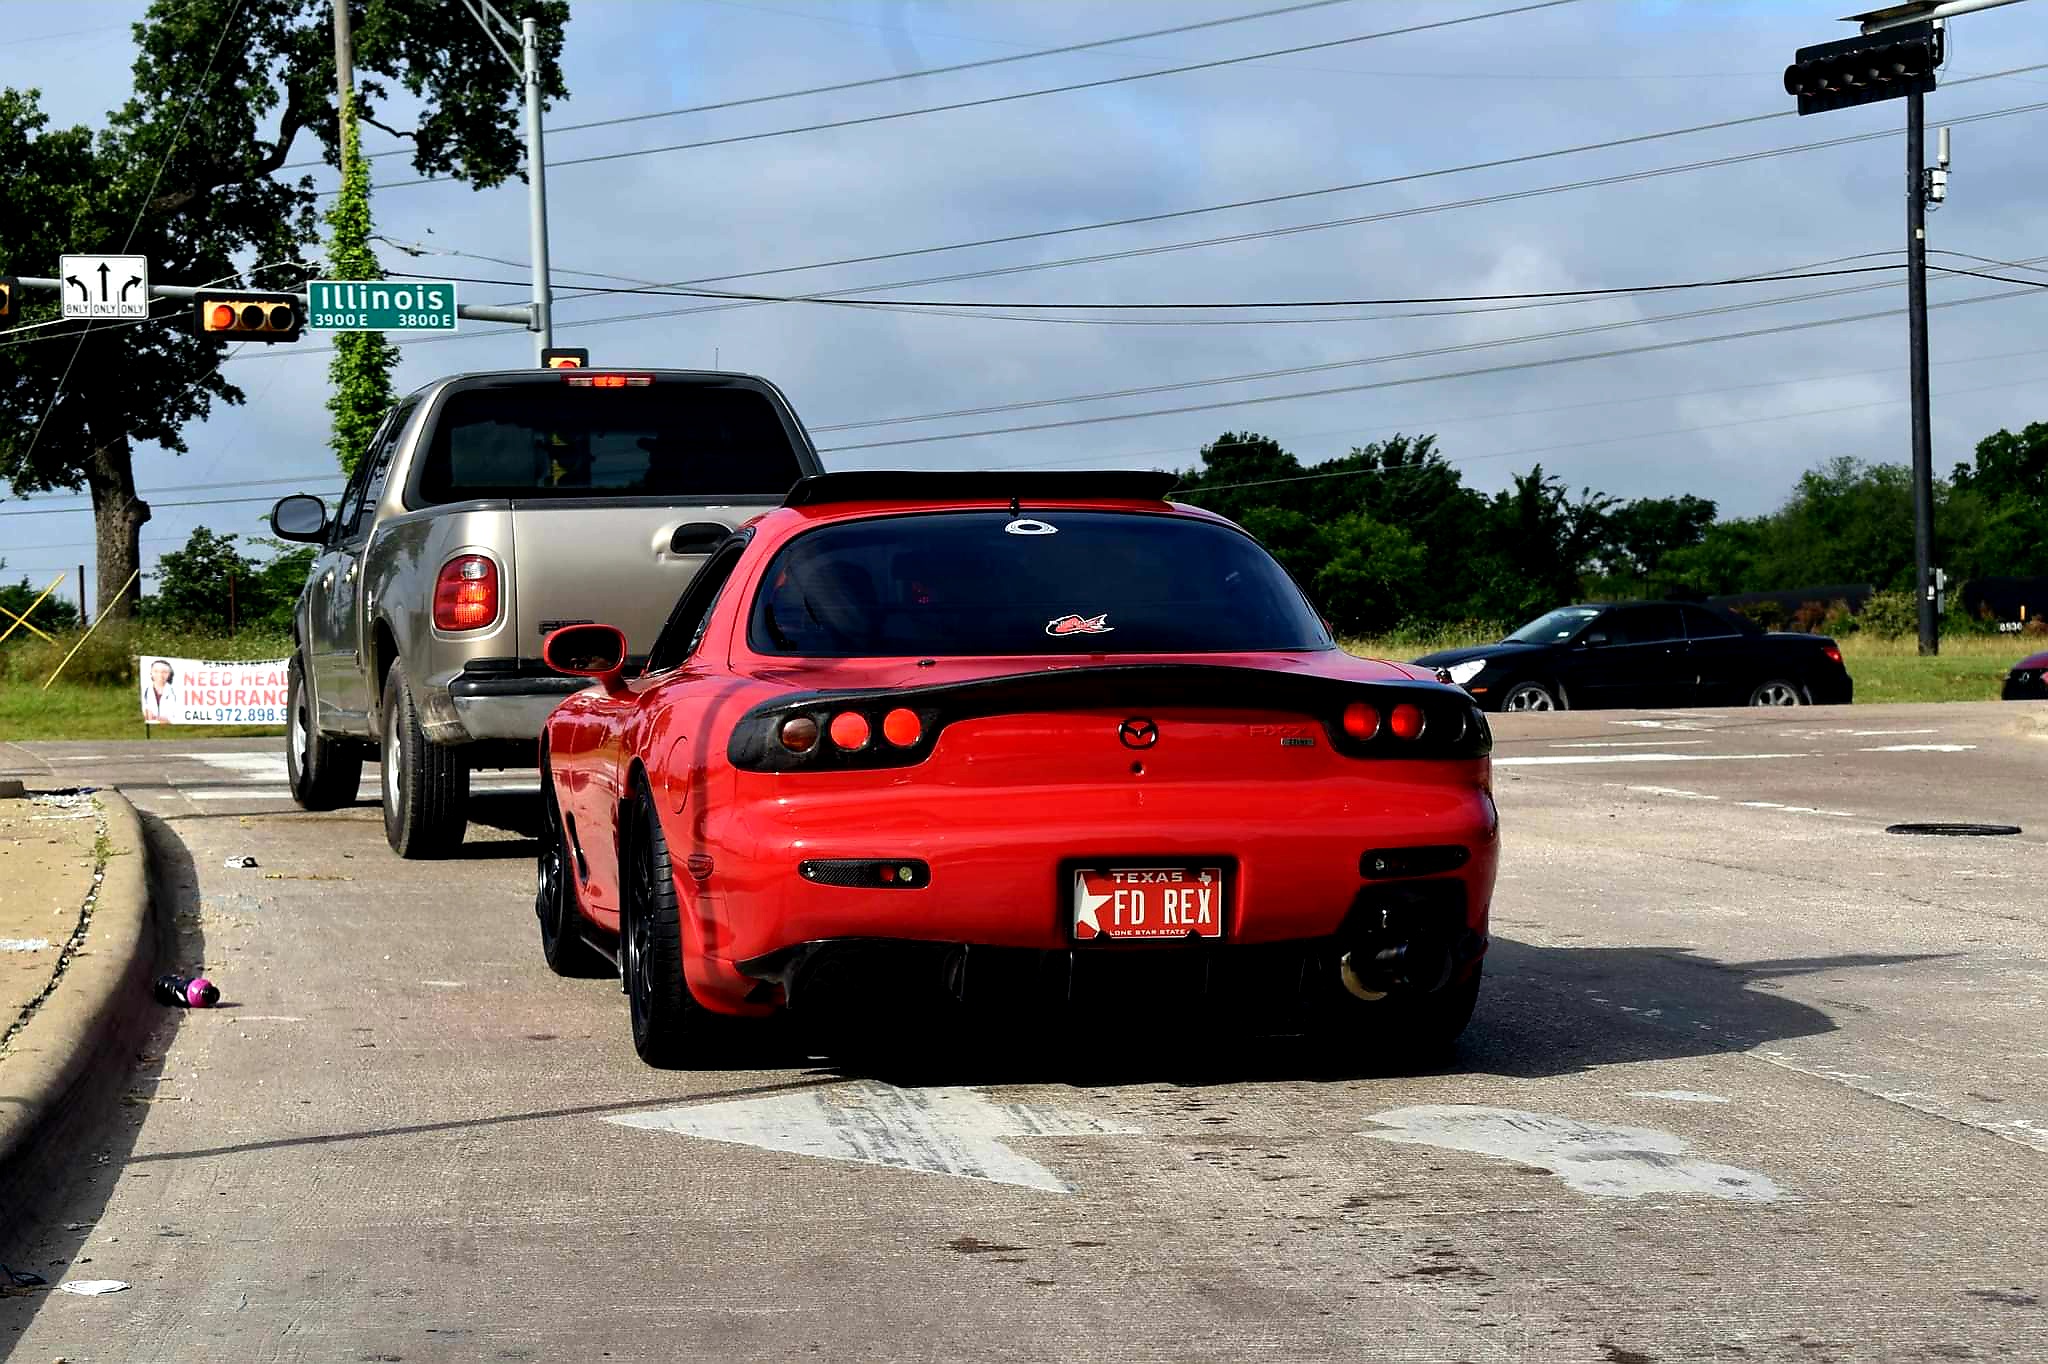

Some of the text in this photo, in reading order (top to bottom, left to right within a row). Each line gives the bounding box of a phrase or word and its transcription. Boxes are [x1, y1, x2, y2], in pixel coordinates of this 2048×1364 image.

[322, 284, 444, 310] Illinois
[66, 304, 143, 314] ONLY ONLY ONLY
[315, 313, 451, 326] 3900 E 3800 E
[183, 671, 233, 687] NEED
[184, 710, 212, 721] CALL
[1112, 872, 1183, 884] TEXAS
[1114, 888, 1211, 926] FD REX
